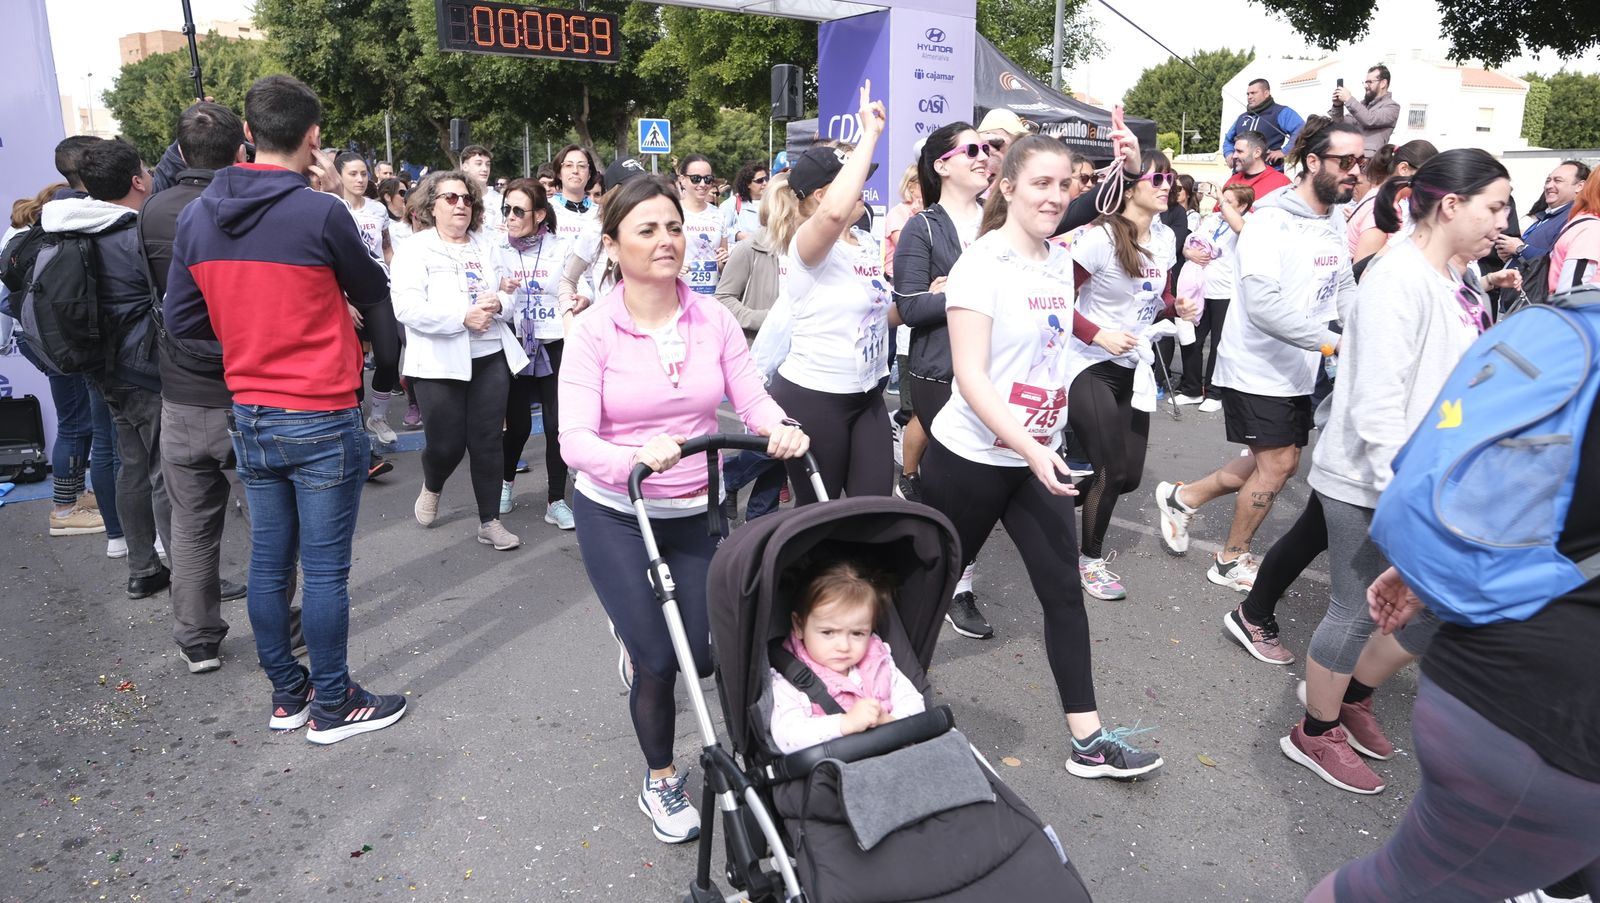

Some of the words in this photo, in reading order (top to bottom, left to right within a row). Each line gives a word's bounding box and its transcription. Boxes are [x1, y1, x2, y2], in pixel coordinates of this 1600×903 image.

[917, 43, 953, 53] HYUNDAI
[926, 71, 955, 81] cajamar
[1314, 255, 1339, 267] MUJER
[514, 270, 549, 279] MUJER
[691, 271, 711, 282] 259
[1028, 297, 1067, 310] MUJER
[521, 307, 555, 320] 1164
[863, 335, 884, 362] 1111
[1024, 408, 1060, 428] 745
